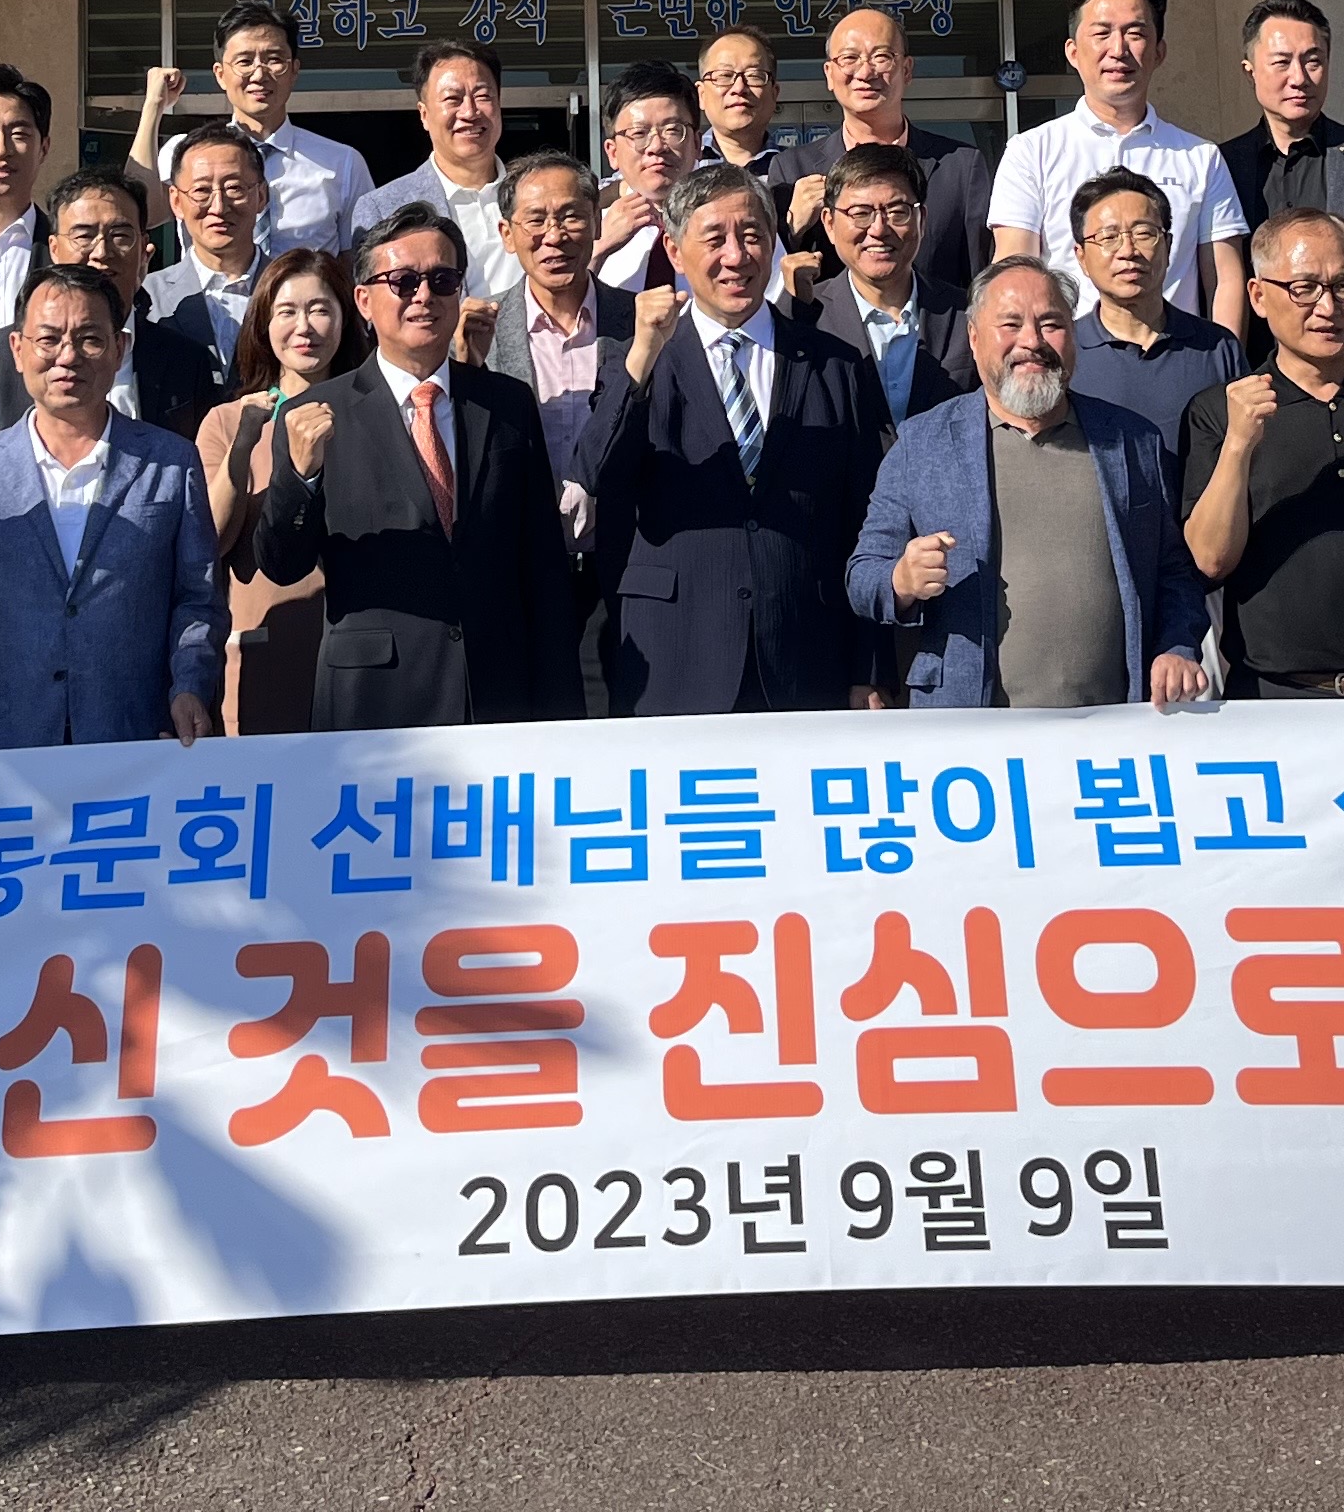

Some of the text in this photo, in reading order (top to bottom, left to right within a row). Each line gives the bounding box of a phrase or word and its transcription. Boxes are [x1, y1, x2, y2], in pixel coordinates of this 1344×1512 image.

[311, 767, 776, 895] 선배님들
[810, 758, 1036, 875] 많이
[1074, 754, 1307, 867] 뵙고
[227, 924, 585, 1148] 것을
[458, 1146, 1169, 1256] 2023년 9월 9일
